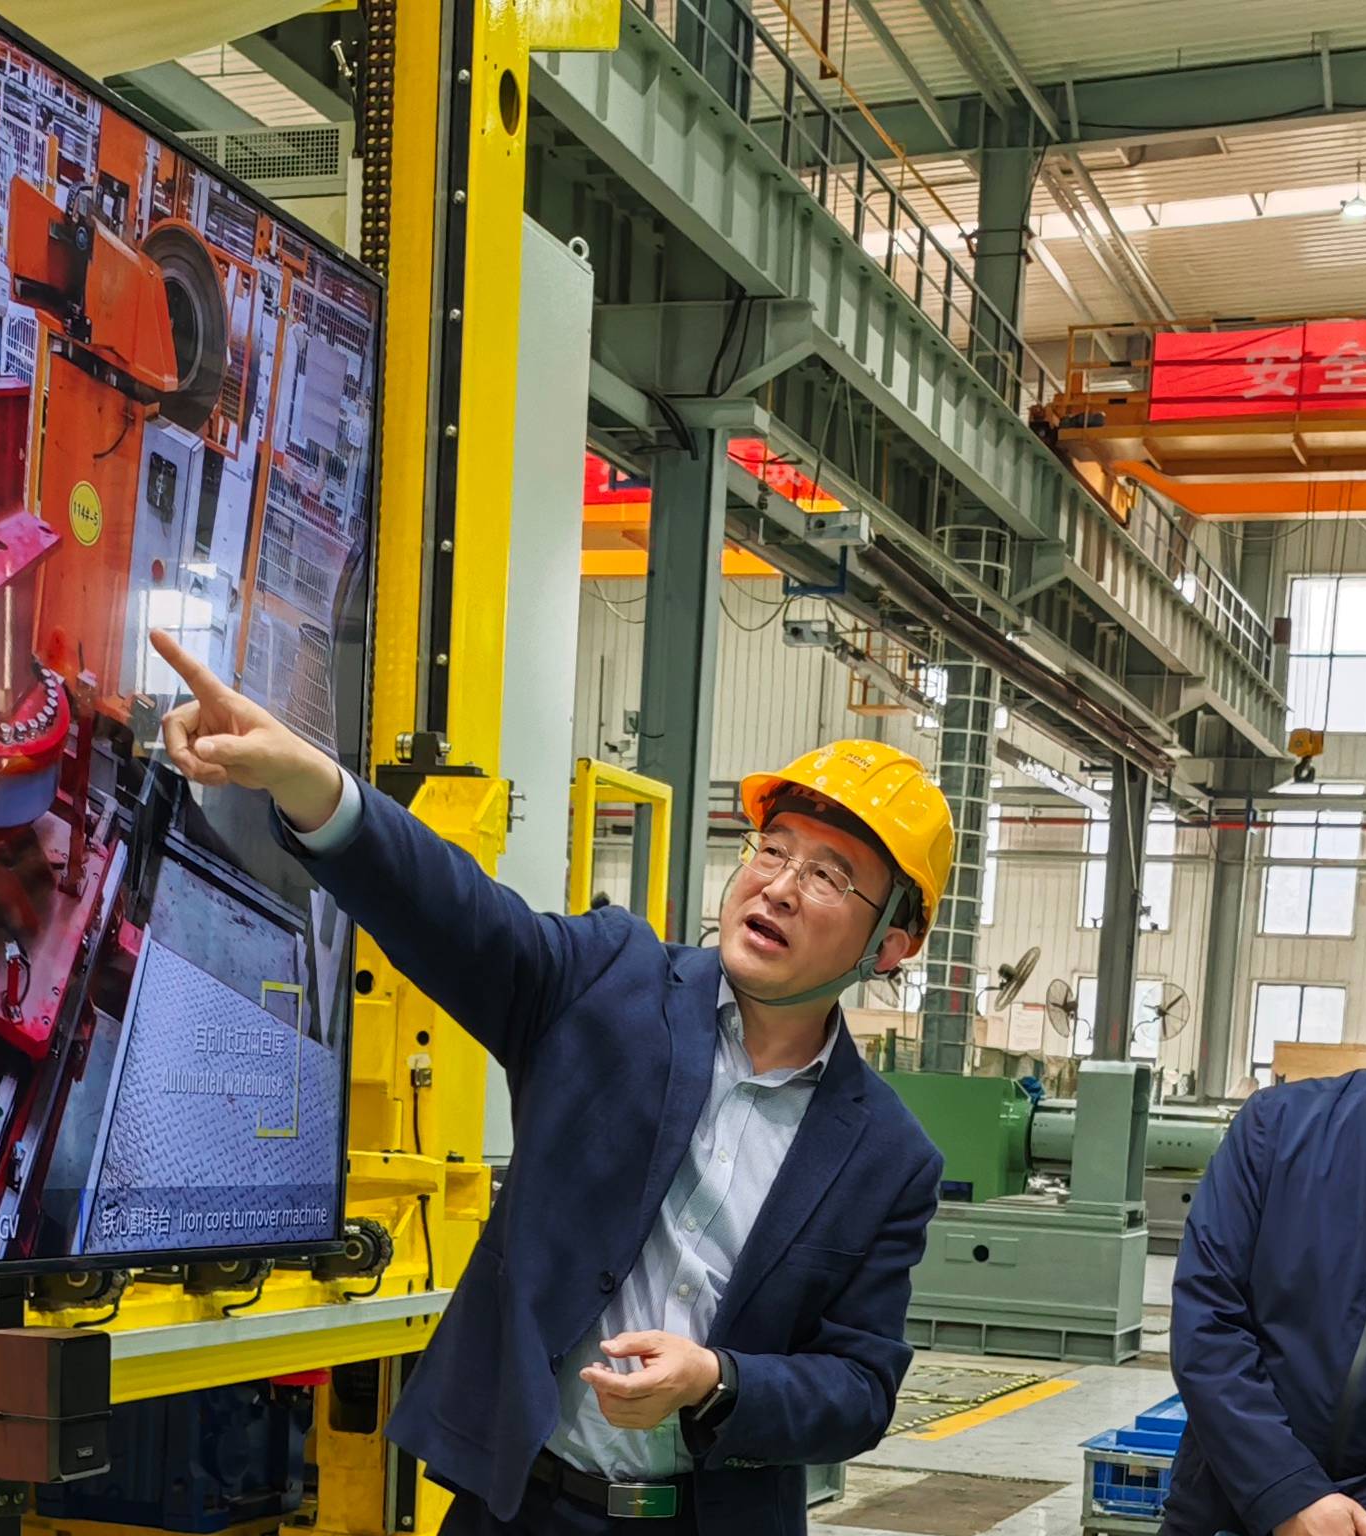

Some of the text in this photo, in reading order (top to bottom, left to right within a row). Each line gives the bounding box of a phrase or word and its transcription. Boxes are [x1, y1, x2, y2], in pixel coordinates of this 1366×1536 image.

[179, 1208, 203, 1231] Iron
[205, 1210, 230, 1229] core
[283, 1202, 328, 1225] machine
